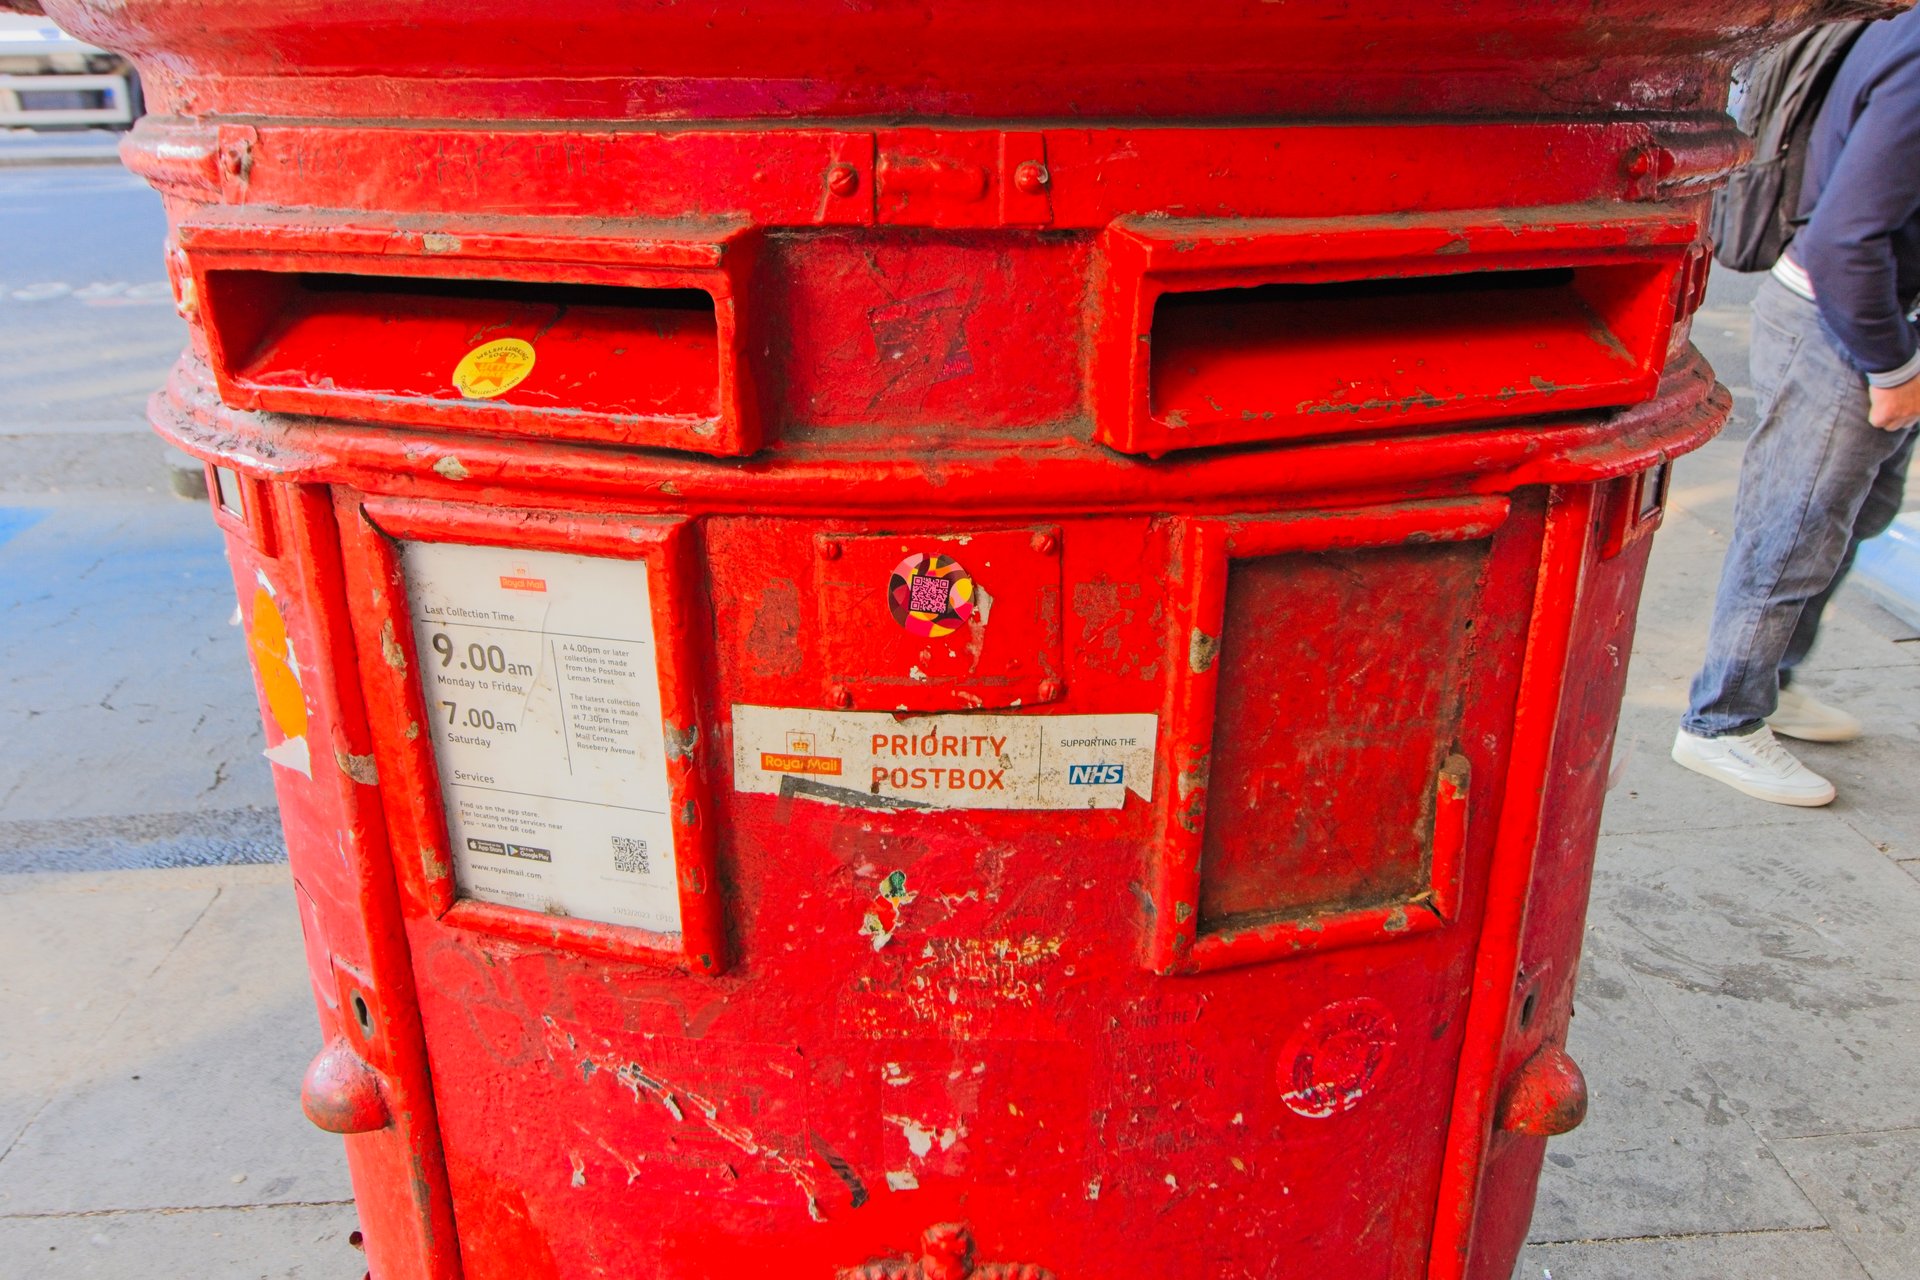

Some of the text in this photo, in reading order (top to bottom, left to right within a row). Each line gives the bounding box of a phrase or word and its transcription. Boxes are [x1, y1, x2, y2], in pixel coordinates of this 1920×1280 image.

[502, 577, 545, 589] Royal Mail
[425, 604, 515, 621] Last Collection Time
[432, 633, 533, 676] 9.00am
[569, 643, 601, 655] 4.00pm
[612, 648, 629, 657] later
[564, 654, 598, 664] collection
[608, 658, 627, 667] made
[565, 663, 583, 672] from
[585, 665, 596, 674] the
[598, 666, 626, 677] Postbox
[437, 675, 523, 695] Monday to Friday
[567, 673, 615, 686] Leman Street
[570, 693, 640, 708] The latest collection
[442, 700, 517, 733] 7.00am
[580, 704, 592, 712] the
[594, 707, 609, 715] area
[620, 709, 639, 717] made
[573, 713, 629, 726] at 7.30pm from
[574, 722, 597, 732] Mount
[448, 732, 491, 748] Saturday
[575, 732, 591, 741] Mail
[1060, 737, 1137, 748] SUPPORTING THE
[871, 734, 1008, 757] PRIORITY
[808, 757, 838, 772] Mail
[454, 770, 495, 784] Services
[871, 767, 1005, 790] POSTBOX
[1070, 764, 1122, 784] NHS
[460, 801, 474, 809] Find
[494, 806, 505, 814] the
[507, 808, 519, 816] app
[461, 809, 472, 817] For
[520, 819, 547, 829] services
[548, 823, 563, 831] near
[463, 819, 475, 828] you
[481, 821, 496, 829] scan
[497, 823, 508, 831] the
[510, 825, 520, 833] QR
[521, 827, 536, 836] code
[520, 850, 538, 860] Google
[538, 852, 549, 862] Play
[470, 862, 542, 880] www.royalmail.com
[475, 885, 499, 894] Postbox
[501, 890, 525, 898] number
